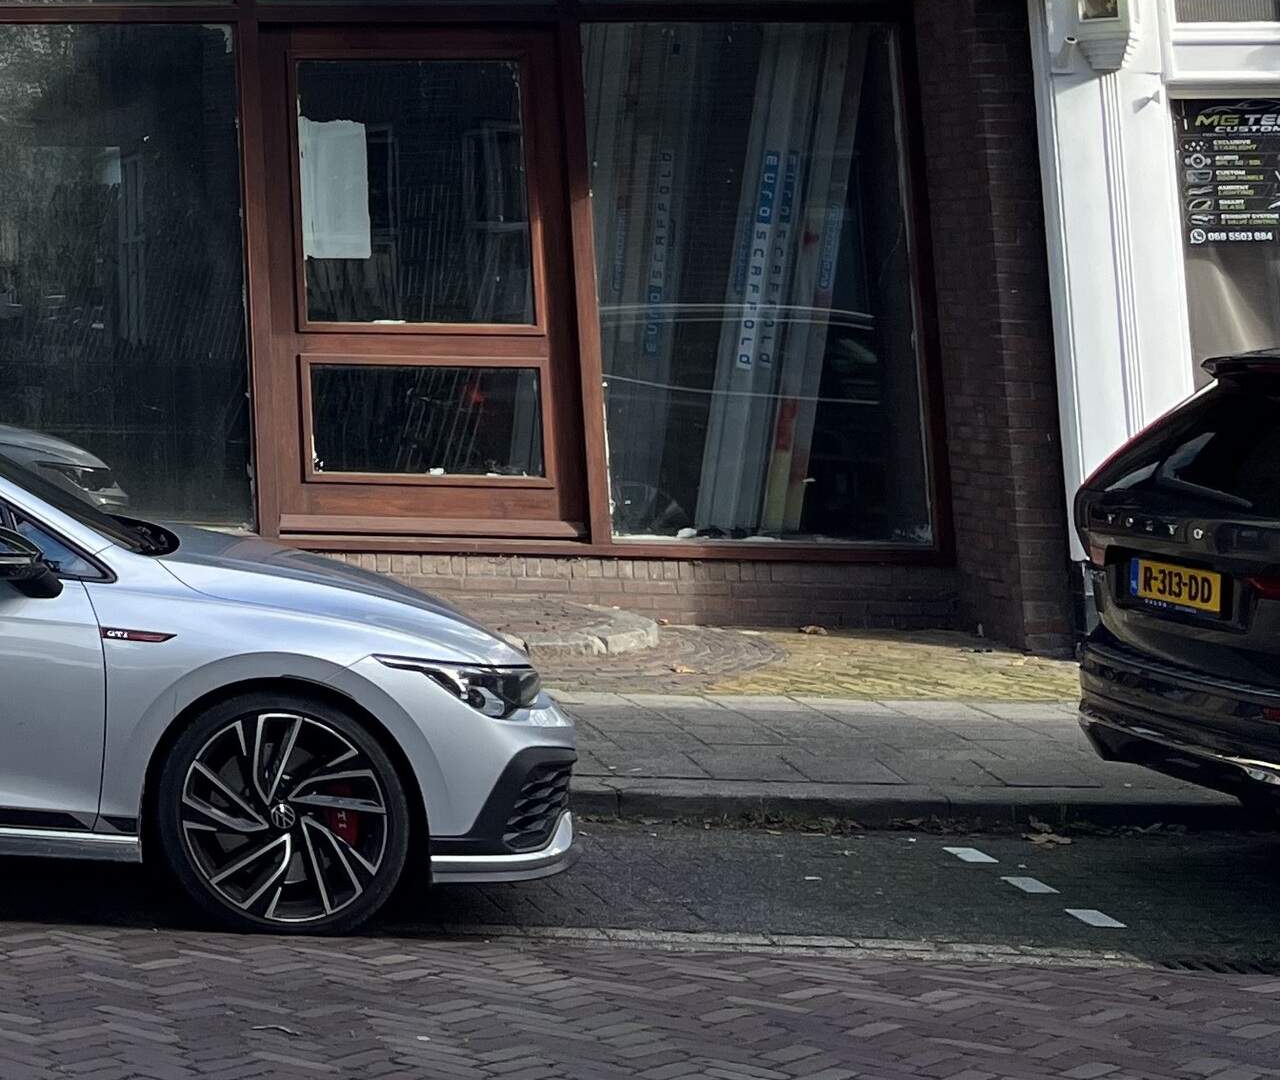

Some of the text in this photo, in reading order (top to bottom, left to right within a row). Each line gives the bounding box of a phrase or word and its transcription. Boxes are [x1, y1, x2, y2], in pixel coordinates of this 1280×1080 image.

[1194, 114, 1280, 127] MG TE
[1143, 565, 1212, 603] R-313-DD
[106, 630, 129, 638] GTI
